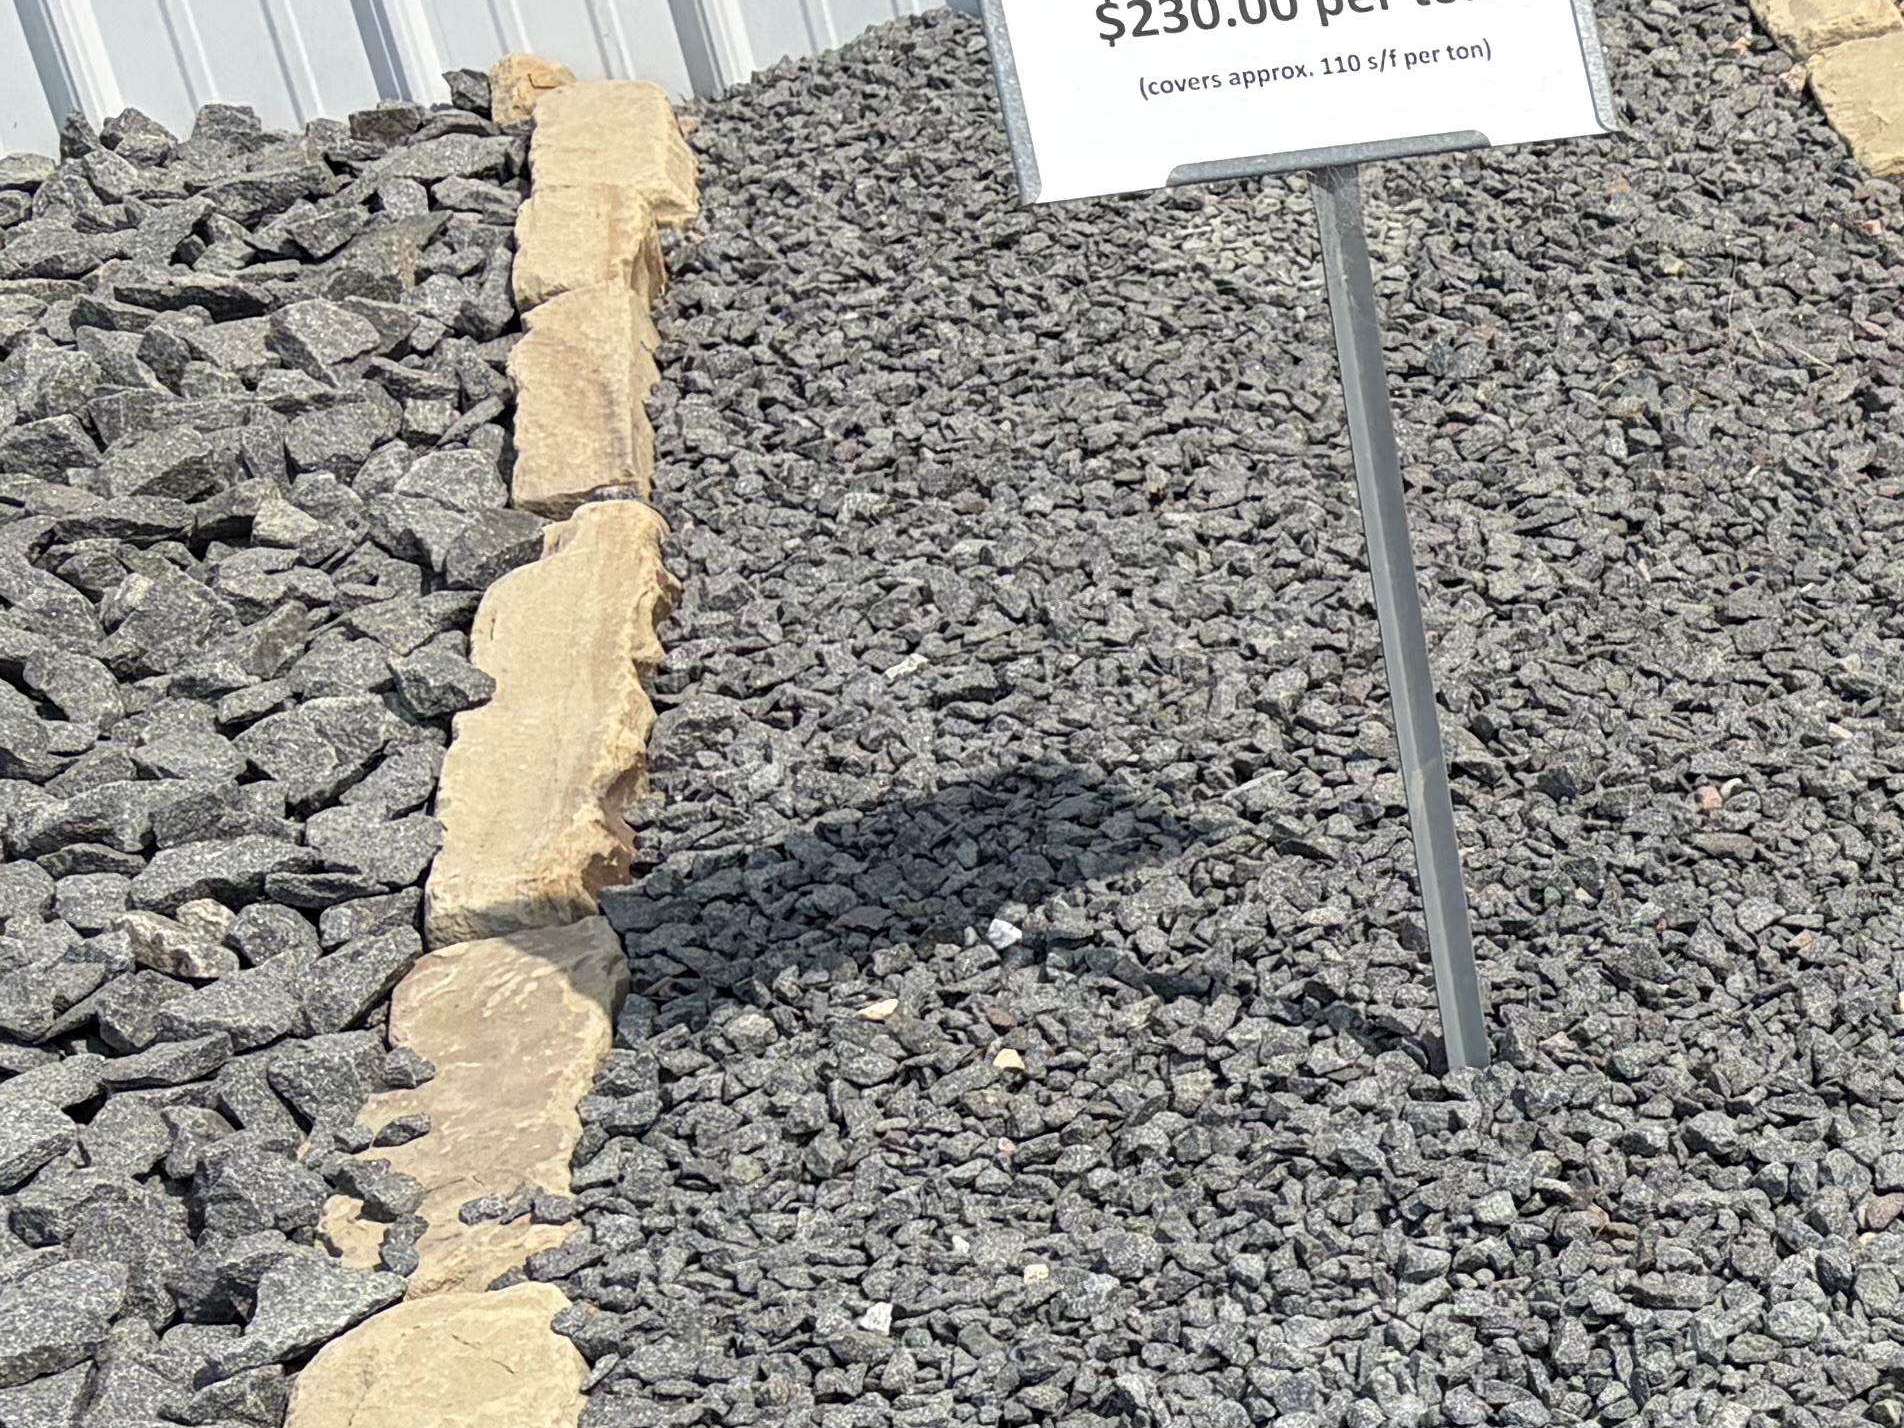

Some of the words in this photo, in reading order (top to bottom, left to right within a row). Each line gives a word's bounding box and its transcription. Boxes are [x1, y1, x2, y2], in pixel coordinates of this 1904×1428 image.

[1139, 74, 1223, 101] (covers
[1228, 64, 1314, 90] approx.
[1320, 54, 1361, 76] 110
[1367, 48, 1397, 73] s/f
[1403, 48, 1441, 71] per
[1445, 37, 1492, 62] ton)
